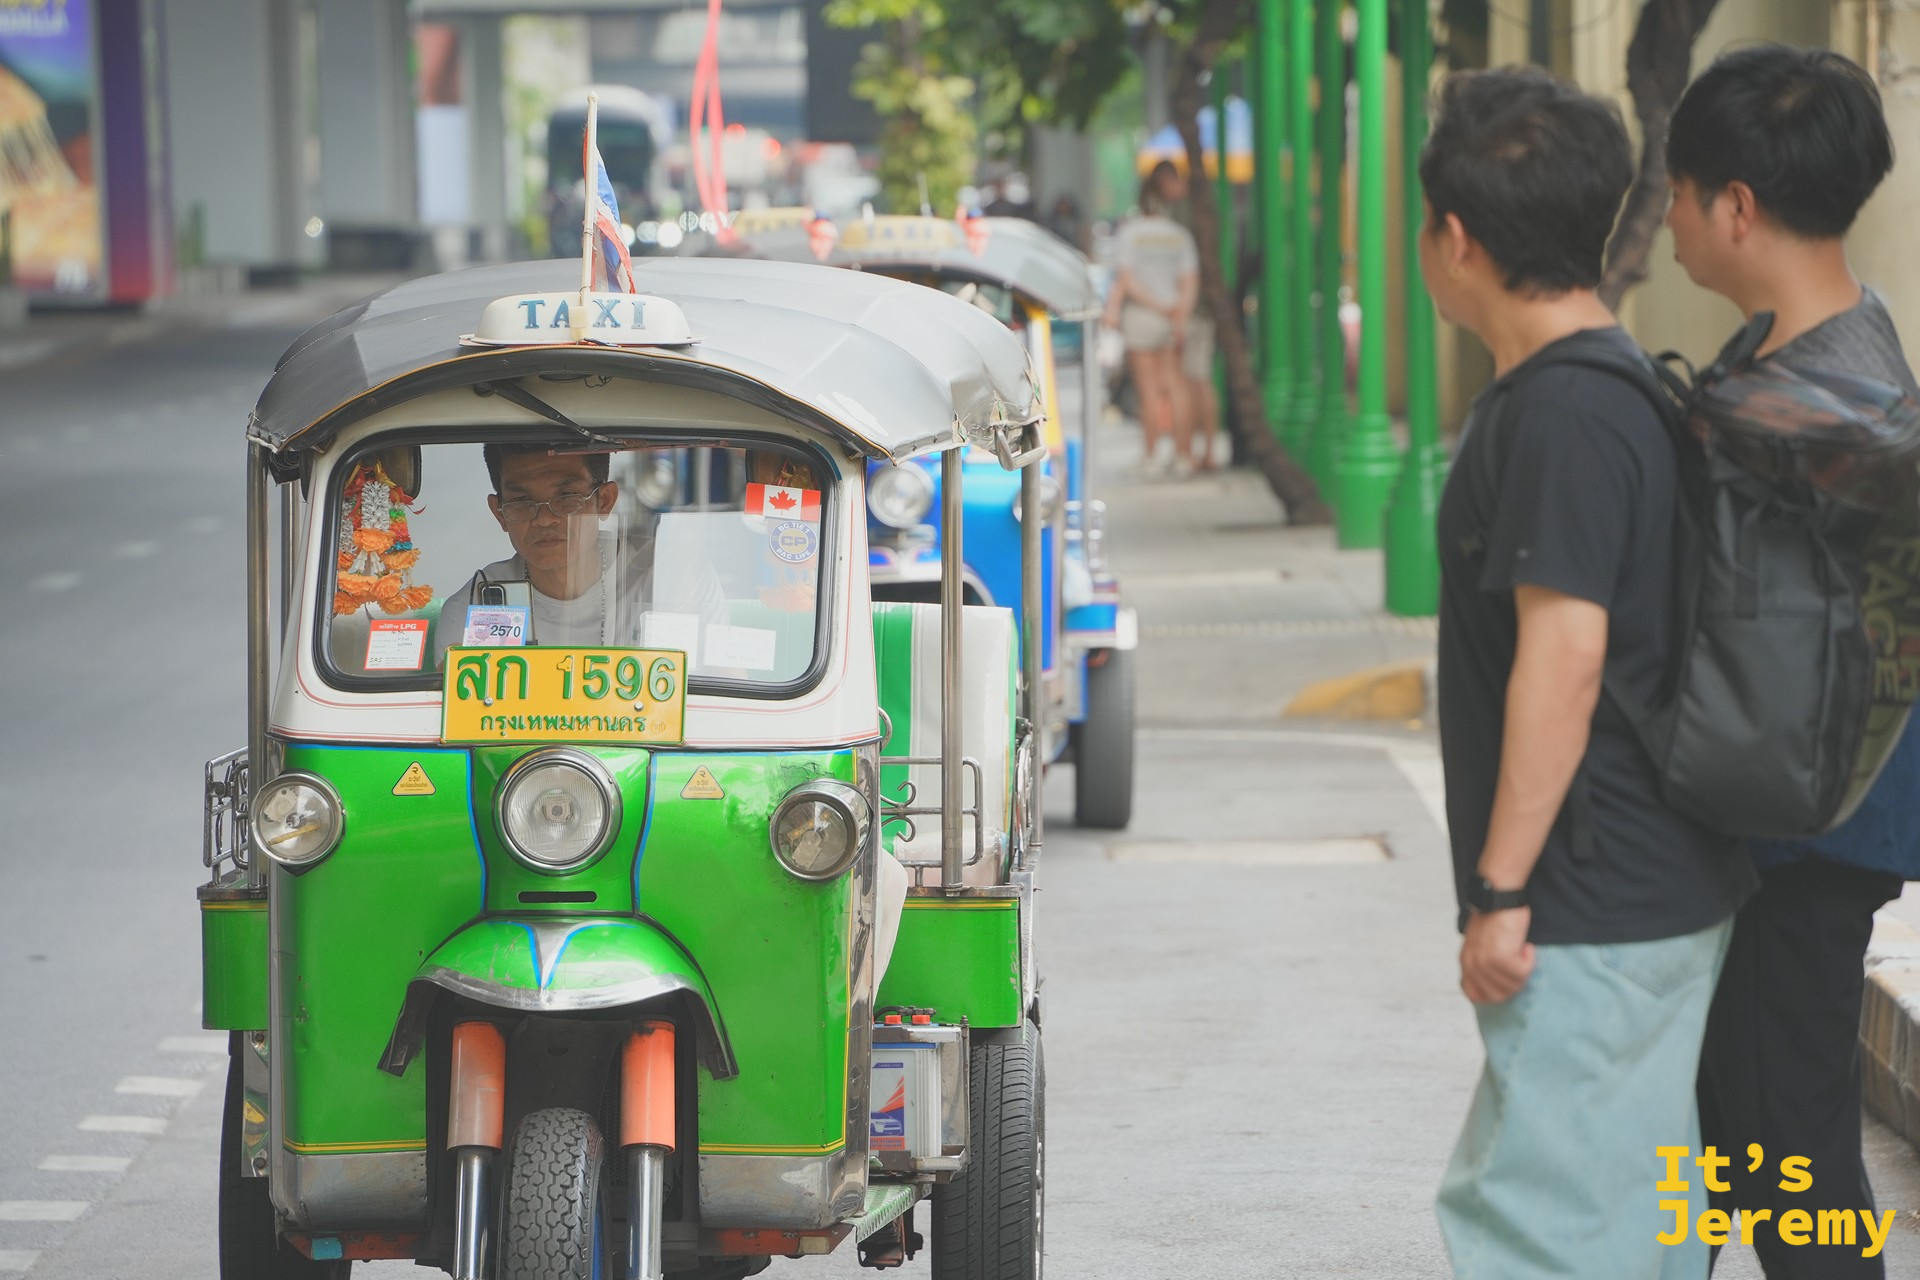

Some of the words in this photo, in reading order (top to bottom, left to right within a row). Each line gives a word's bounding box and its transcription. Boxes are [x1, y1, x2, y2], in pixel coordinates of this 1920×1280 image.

[518, 299, 647, 330] TAXI
[490, 625, 521, 638] 2570
[457, 653, 530, 701] สก
[556, 655, 677, 702] 1596
[481, 714, 648, 737] กรุงเทพมหานคร
